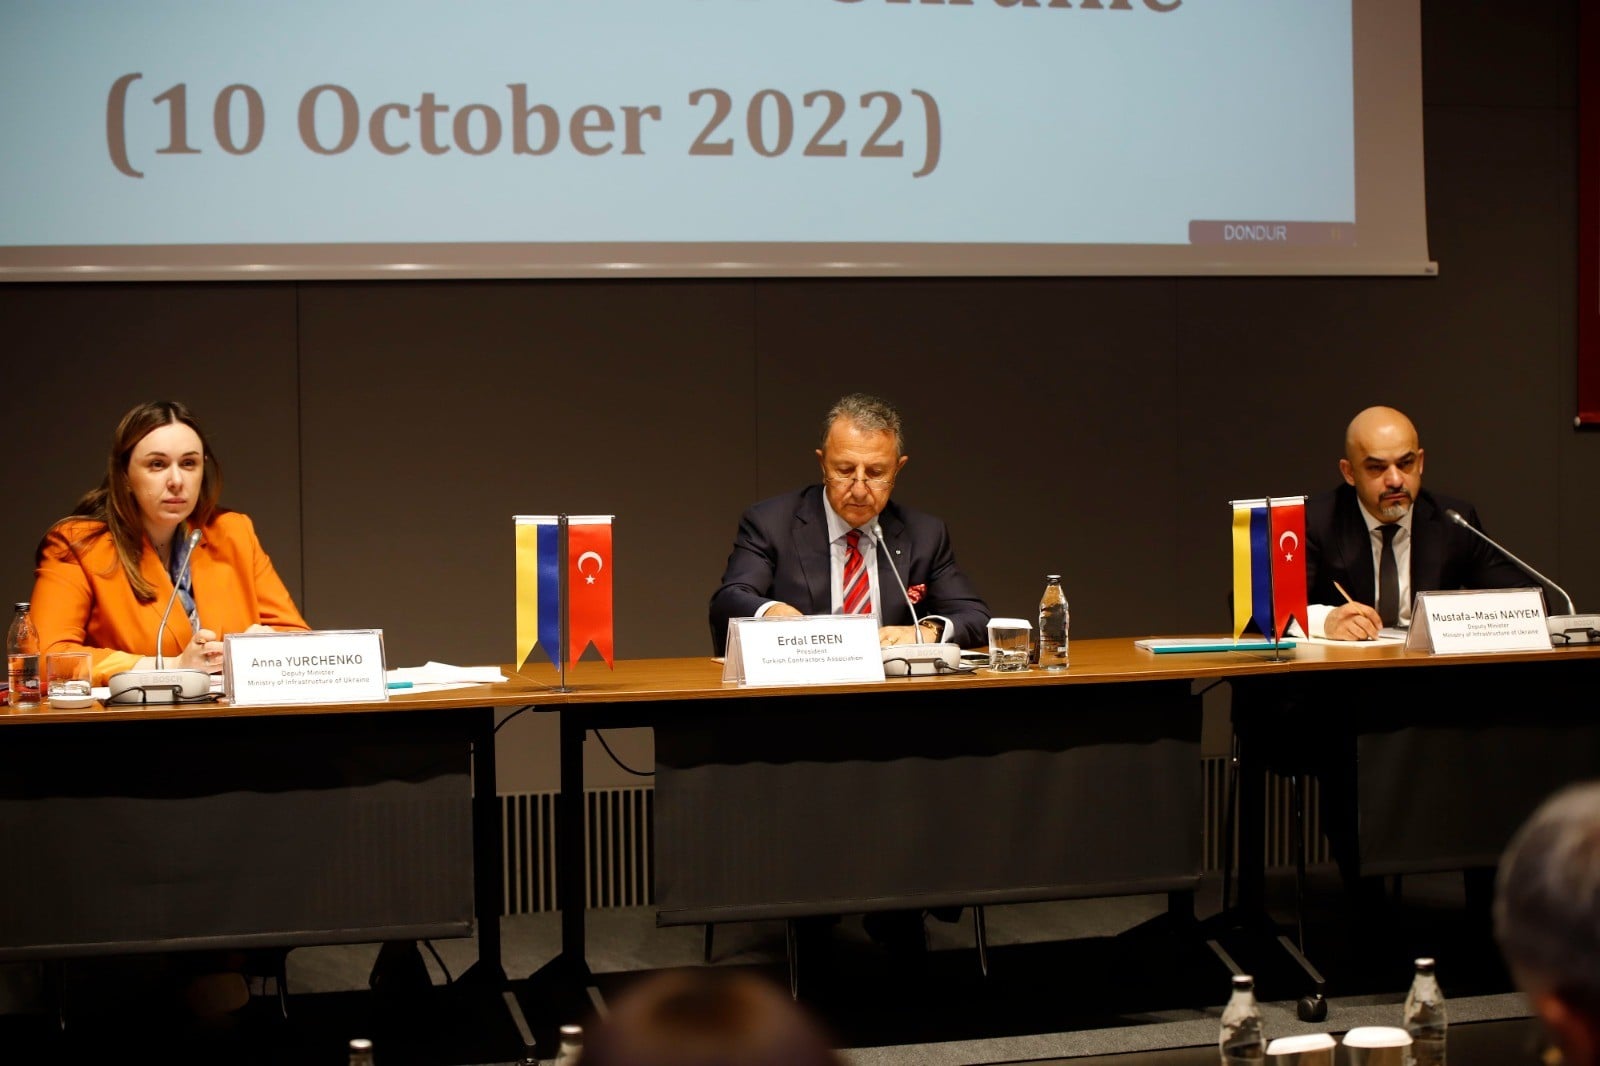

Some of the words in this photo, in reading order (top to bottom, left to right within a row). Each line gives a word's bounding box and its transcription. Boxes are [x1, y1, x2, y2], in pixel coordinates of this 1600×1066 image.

[105, 73, 266, 178] (10
[298, 83, 661, 156] October
[688, 88, 942, 178] 2022)
[1224, 224, 1287, 241] DONDUR
[1432, 611, 1498, 622] Mustafa-Masi
[1500, 609, 1540, 619] NAYYEM
[777, 636, 808, 646] Erdal
[811, 634, 843, 645] EREN
[251, 658, 282, 668] Anna
[285, 654, 363, 667] YURCHENKO
[152, 674, 183, 684] BOSCH
[247, 679, 275, 687] Ministry
